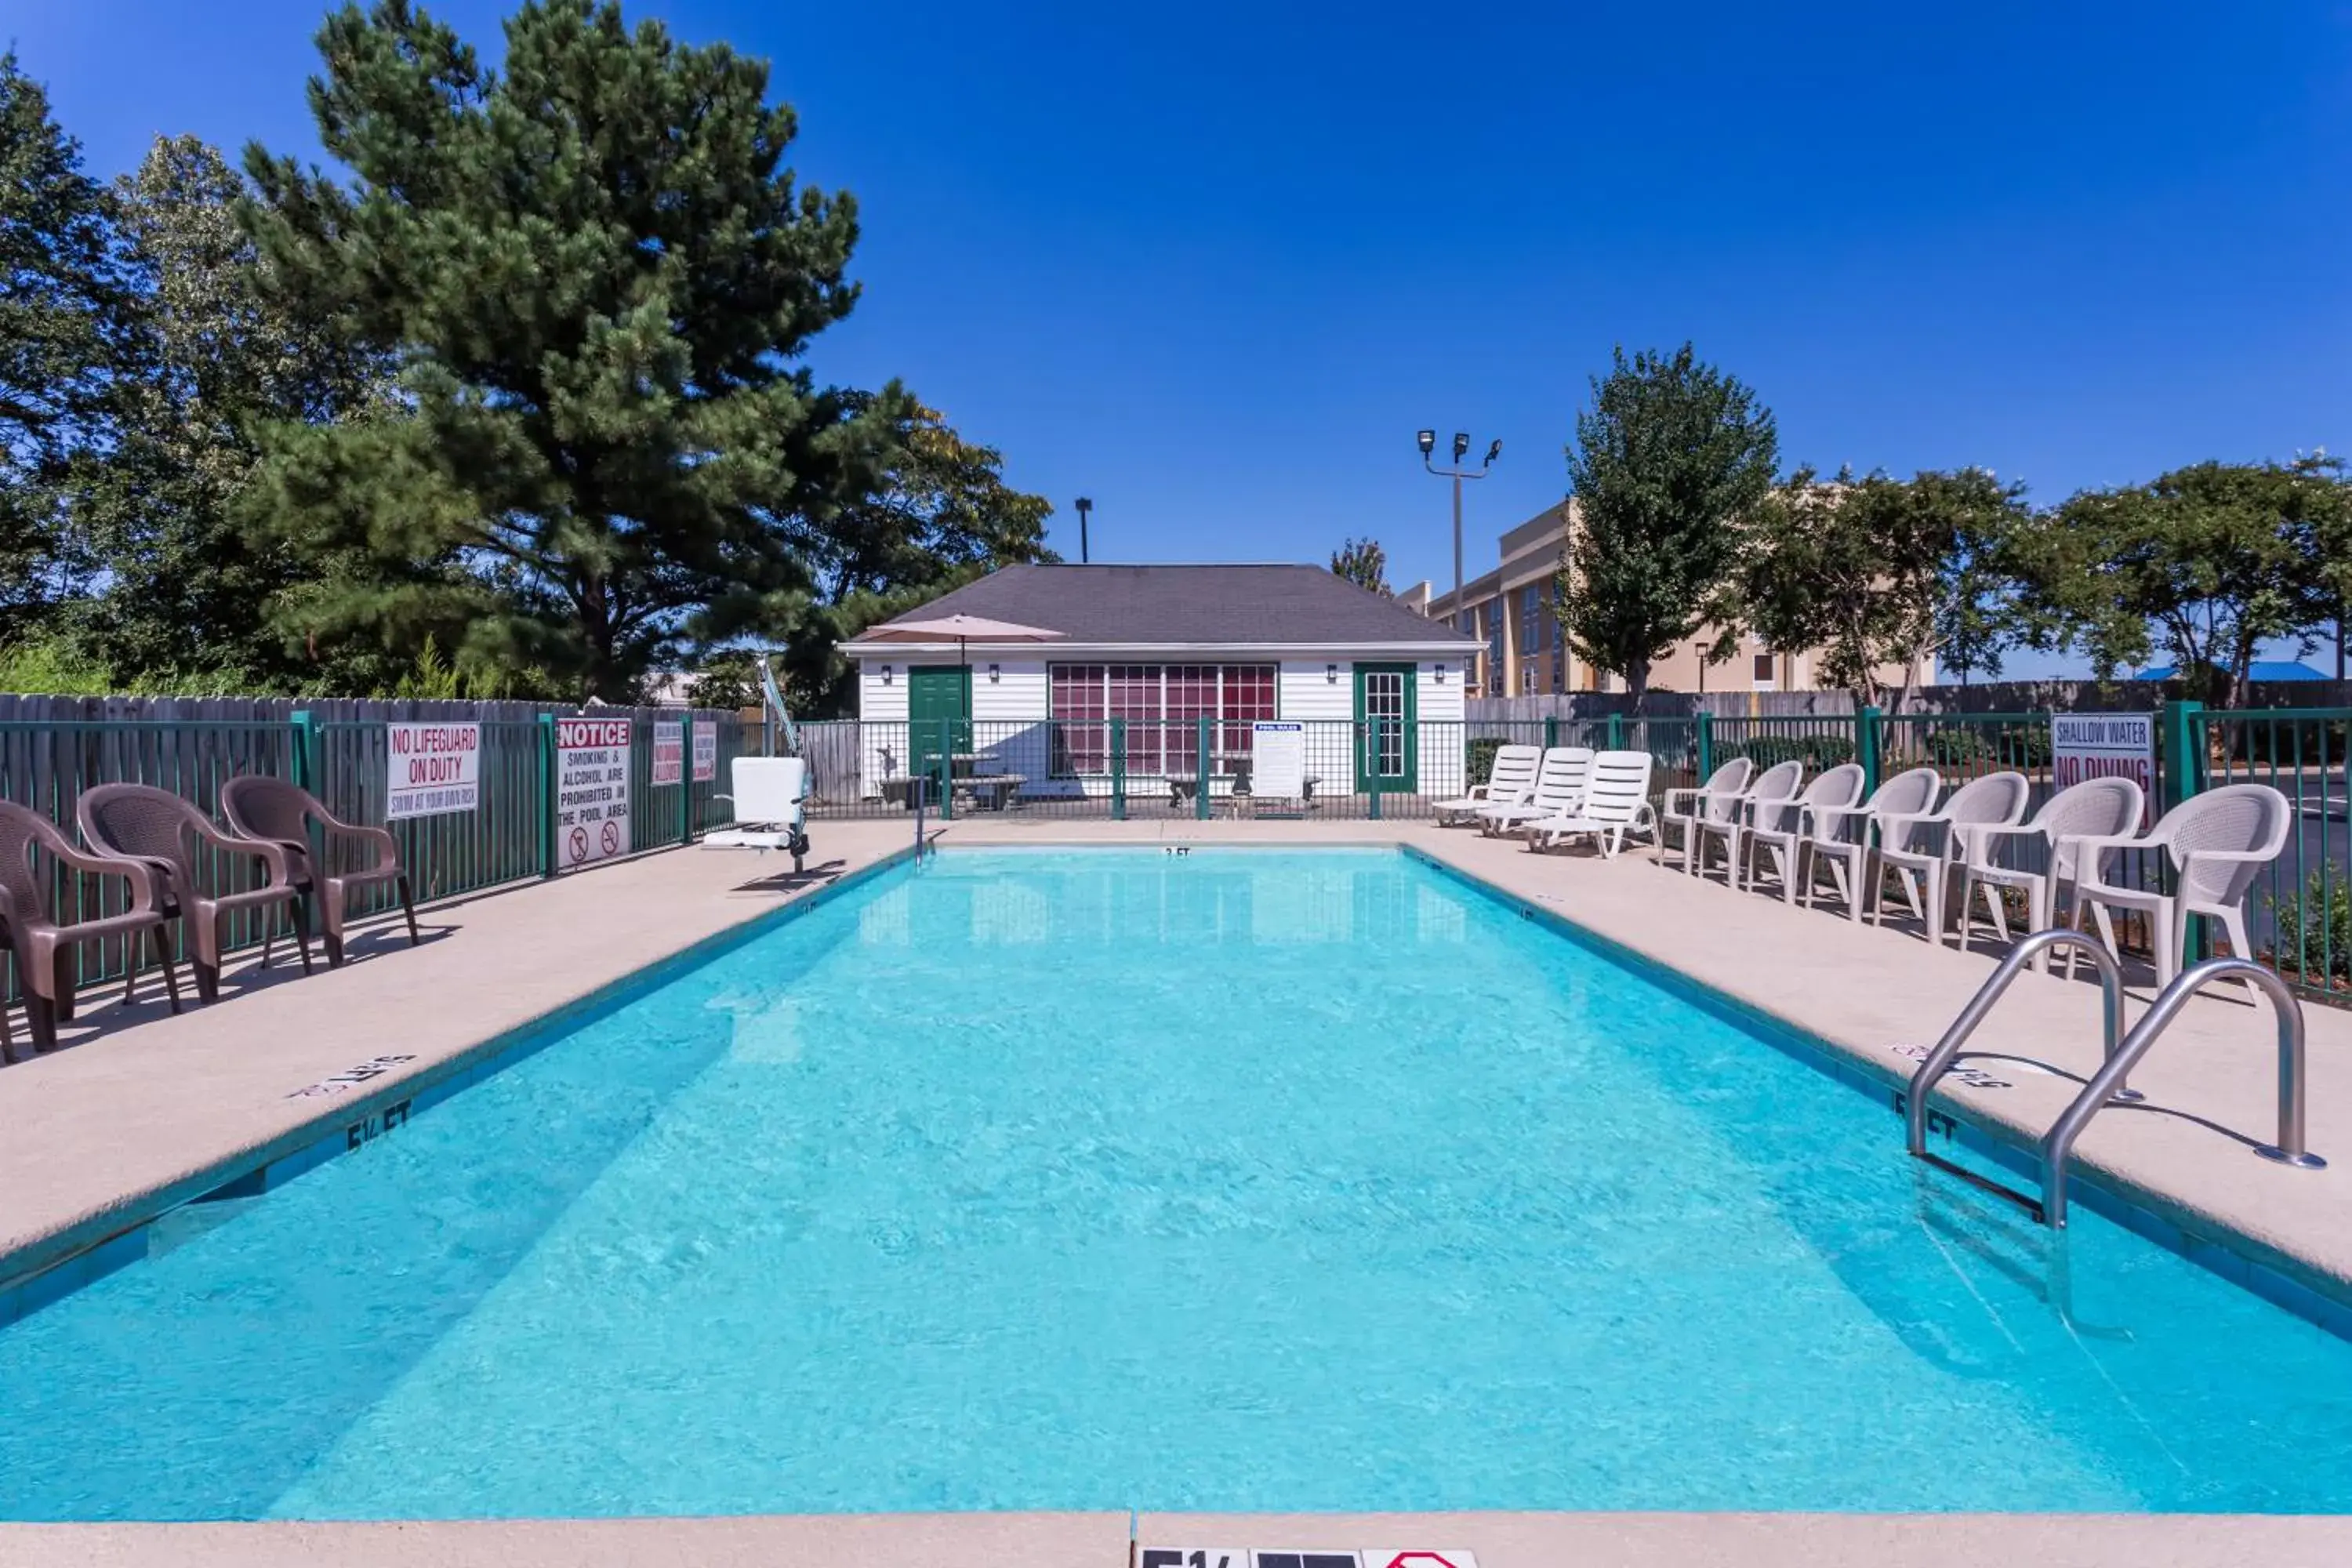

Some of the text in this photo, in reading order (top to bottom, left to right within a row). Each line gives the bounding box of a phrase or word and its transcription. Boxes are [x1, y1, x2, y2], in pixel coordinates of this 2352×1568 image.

[393, 728, 476, 754] NO LIFEGUARD
[559, 723, 628, 746] NOTICE
[2056, 721, 2146, 744] SHALLOW WATER
[568, 750, 608, 767] SMOKING
[410, 757, 461, 783] ON DUTY
[563, 768, 623, 786] ALCOHOL ARE
[2057, 757, 2148, 792] NO DIVING
[391, 794, 413, 813] SWIM
[416, 793, 424, 810] AT
[561, 786, 625, 807] PROHIBITED IN
[557, 804, 627, 826] THE POOL AREA
